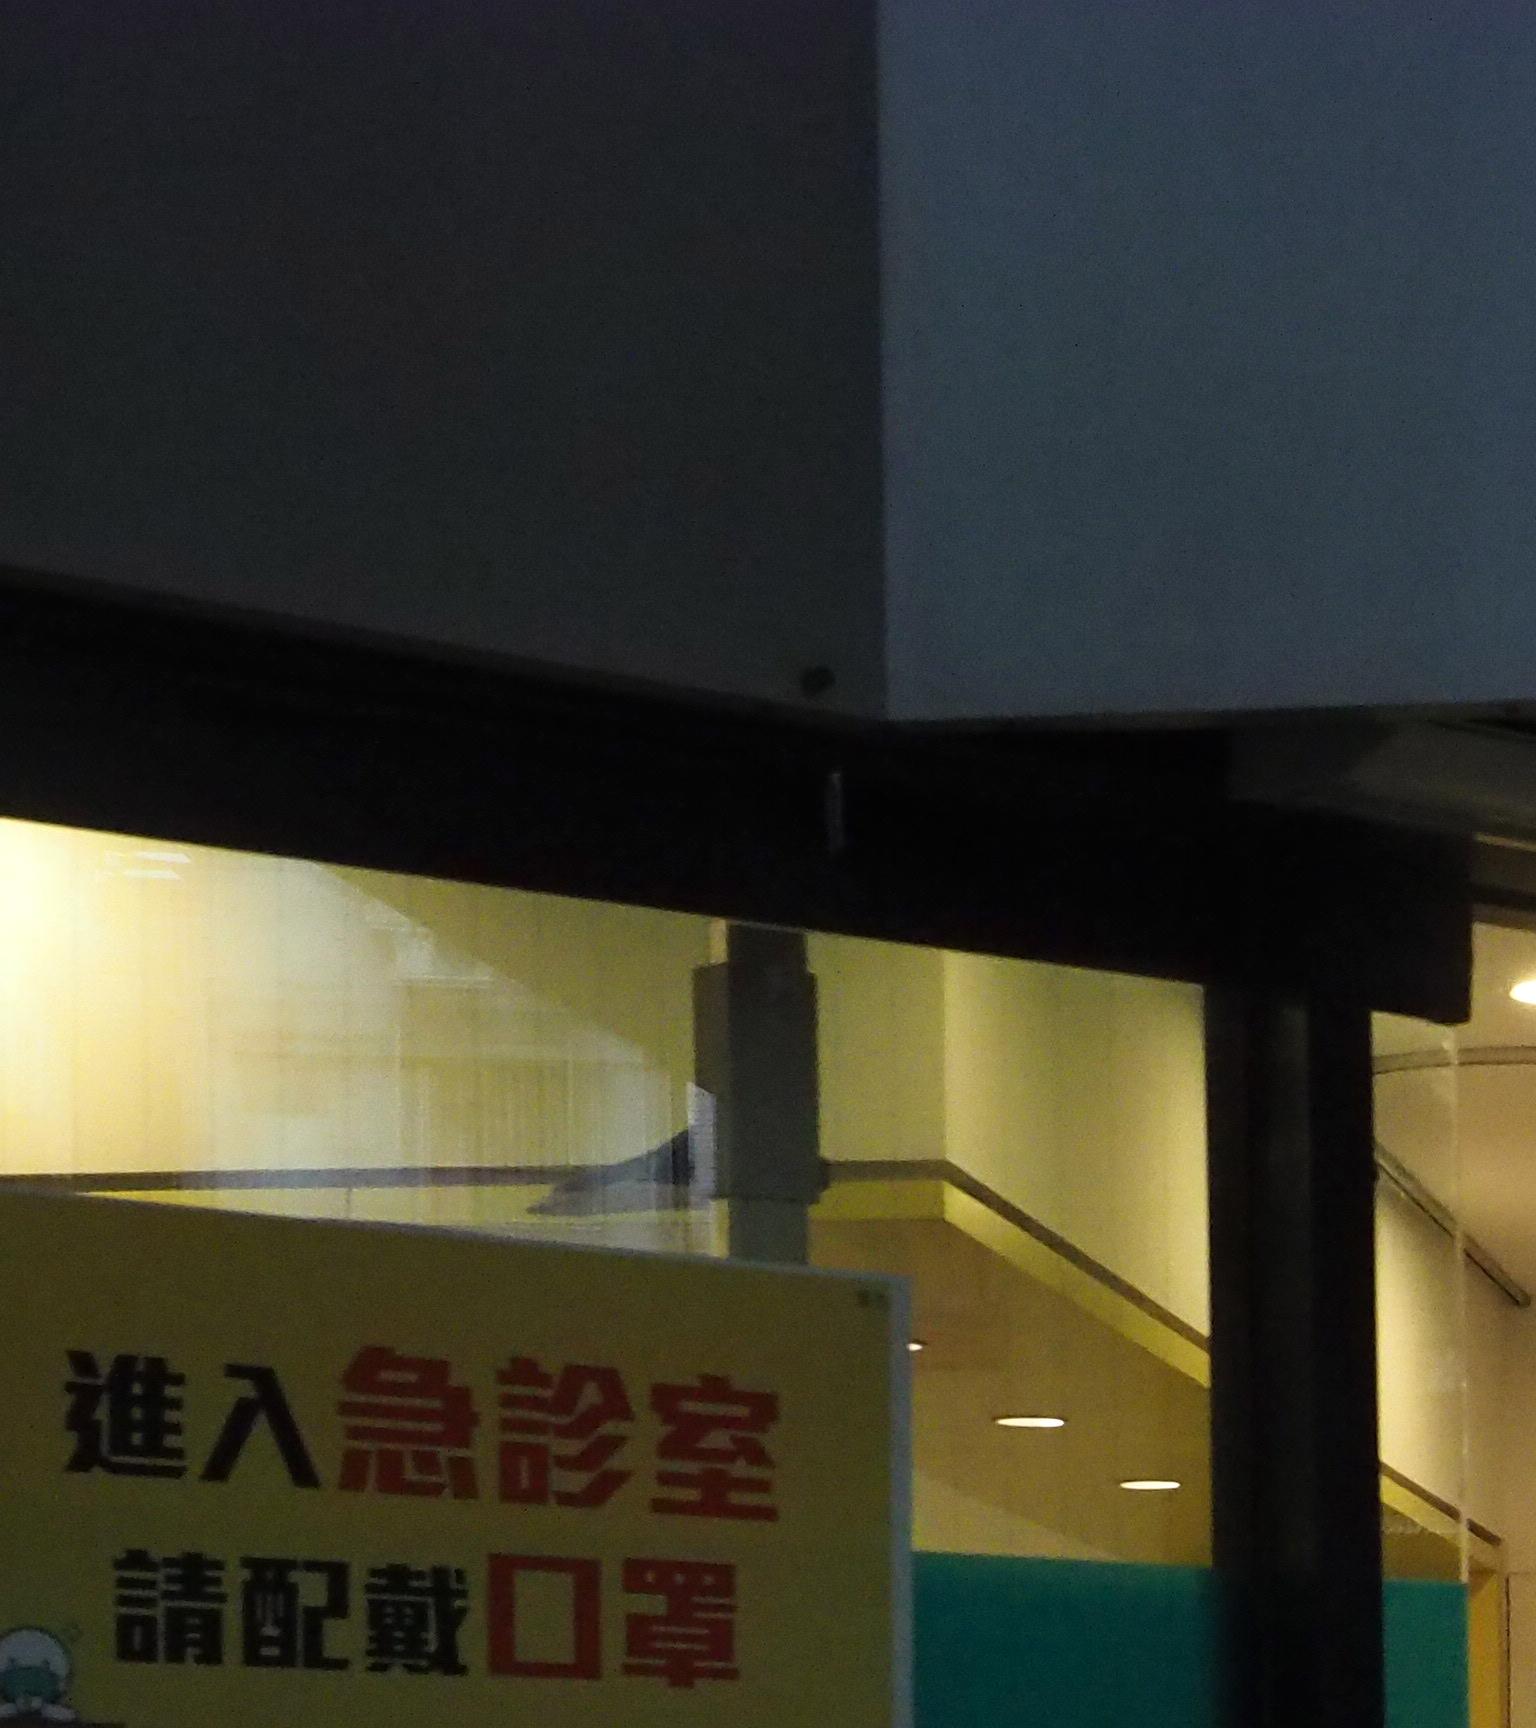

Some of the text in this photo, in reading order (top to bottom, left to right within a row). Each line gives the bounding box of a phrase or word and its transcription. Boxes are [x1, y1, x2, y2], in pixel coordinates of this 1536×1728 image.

[64, 1345, 782, 1522] 進入急診室
[112, 1549, 742, 1690] 請配戴口罩
